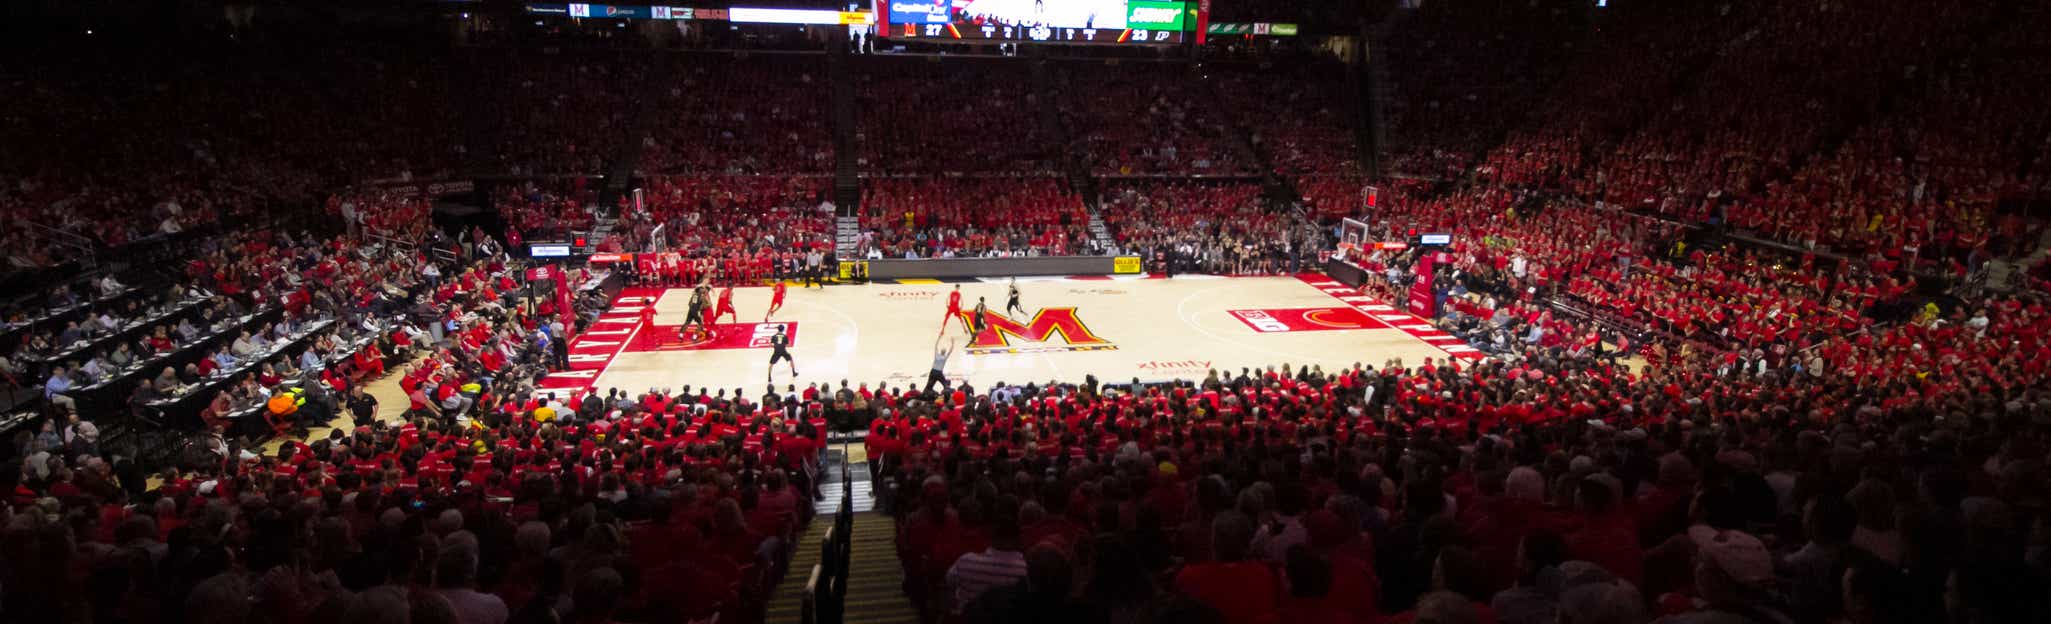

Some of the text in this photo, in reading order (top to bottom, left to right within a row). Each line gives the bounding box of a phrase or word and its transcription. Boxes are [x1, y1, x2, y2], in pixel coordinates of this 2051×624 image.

[574, 4, 584, 14] M
[1129, 7, 1181, 23] SUBWAY
[905, 23, 916, 36] M
[926, 24, 942, 36] 27
[1131, 30, 1147, 41] 23
[959, 306, 1113, 347] M
